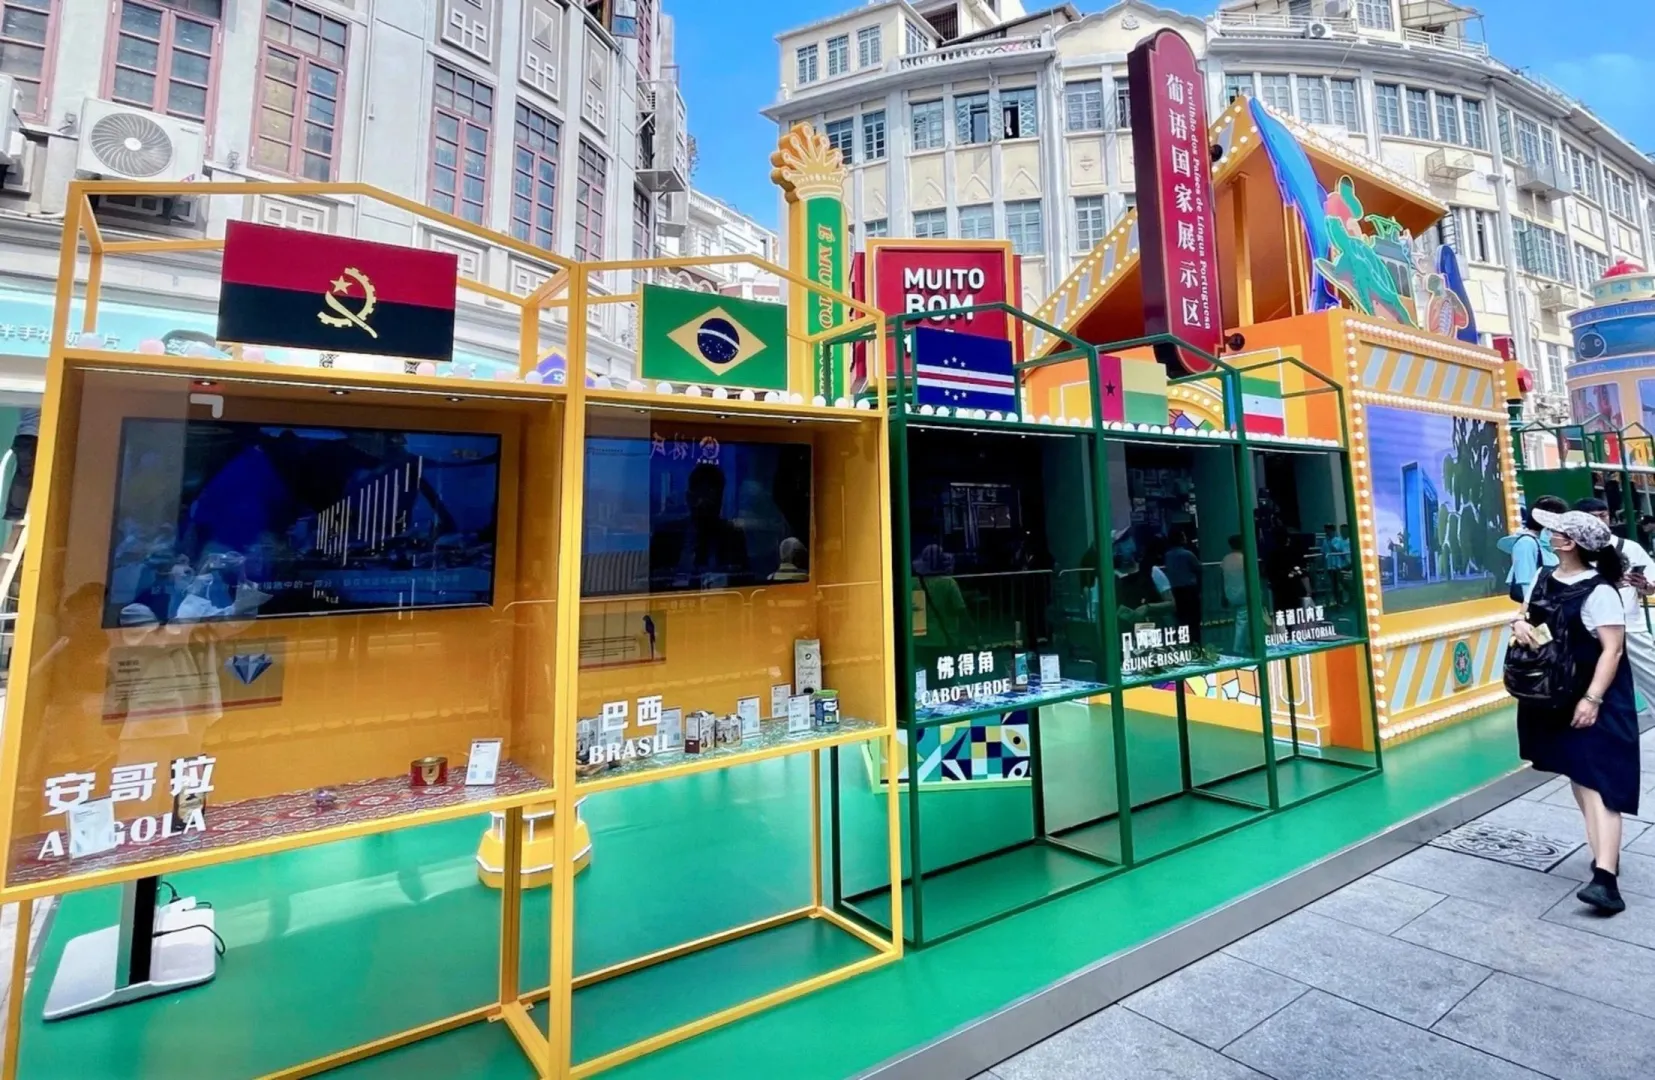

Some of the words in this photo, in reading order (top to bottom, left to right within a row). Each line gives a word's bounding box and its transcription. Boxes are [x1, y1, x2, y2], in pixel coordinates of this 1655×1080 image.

[1187, 81, 1199, 132] Pavilhão
[1191, 135, 1199, 155] dos
[1166, 73, 1202, 327] 葡语国家展示区
[1195, 197, 1204, 213] de
[1196, 215, 1206, 257] Língua
[818, 243, 834, 329] MUTO
[903, 267, 985, 291] MUITO
[906, 293, 974, 321] BOM
[1200, 260, 1211, 330] Portuguesa
[1291, 625, 1337, 643] EQUATORIAL
[937, 651, 994, 680] 佛得角
[1122, 650, 1192, 672] GUINÉ-BISSAU
[921, 686, 961, 706] CABO
[966, 678, 1012, 698] VERDE
[602, 695, 663, 732] 巴西
[589, 734, 668, 765] BRASIL
[42, 756, 217, 817] 安哥拉
[37, 807, 207, 861] AGOLA
